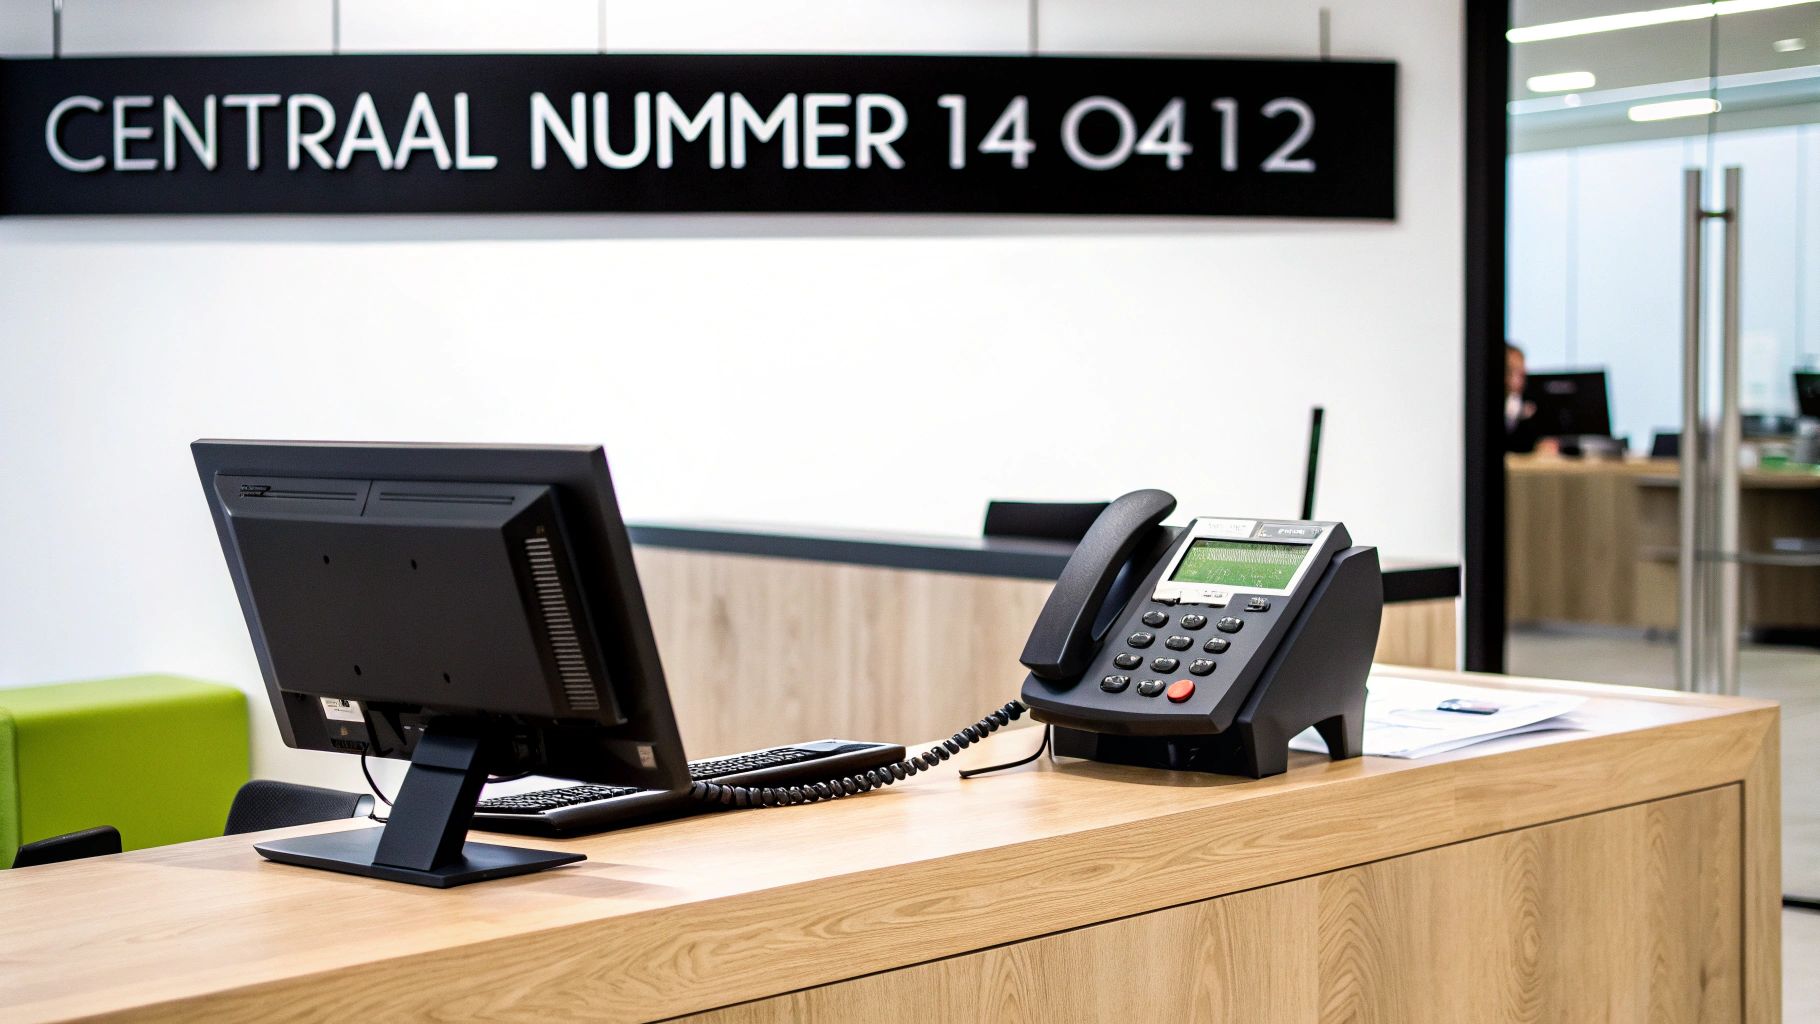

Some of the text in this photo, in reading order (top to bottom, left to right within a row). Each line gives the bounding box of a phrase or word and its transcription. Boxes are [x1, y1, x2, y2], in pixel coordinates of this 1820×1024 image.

[45, 91, 498, 171] CENTRAAL
[530, 91, 907, 170] NUMMER
[938, 95, 1035, 169] 14
